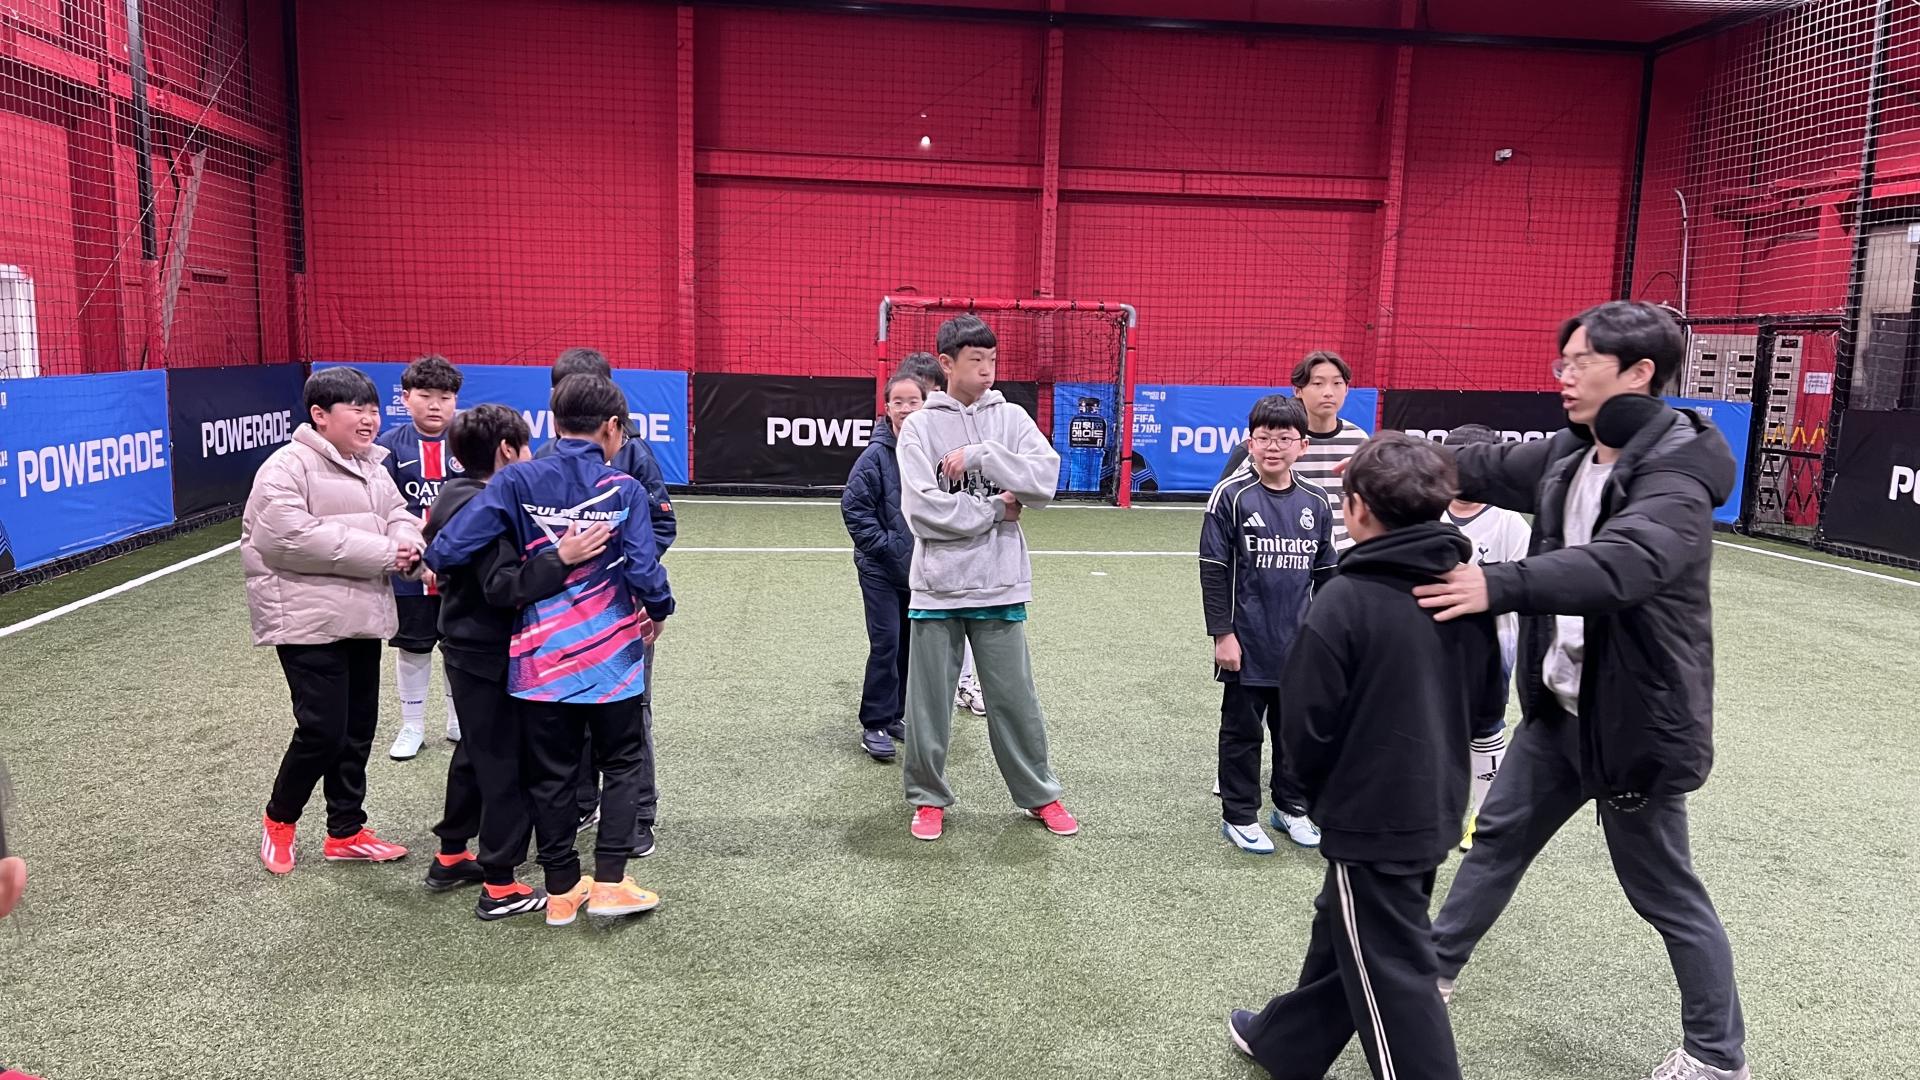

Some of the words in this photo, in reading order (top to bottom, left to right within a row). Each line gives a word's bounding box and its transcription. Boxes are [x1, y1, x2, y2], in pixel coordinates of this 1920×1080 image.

[1133, 414, 1155, 423] FIFA
[202, 410, 292, 458] POWERADE
[767, 417, 876, 447] POWE
[1170, 426, 1250, 454] POW
[18, 429, 165, 498] POWERADE
[405, 481, 447, 499] QAT
[522, 503, 580, 519] PULSE
[583, 511, 623, 521] NINE
[1244, 535, 1319, 554] Emirates
[1256, 554, 1274, 569] FLY
[1276, 554, 1310, 570] BETTER
